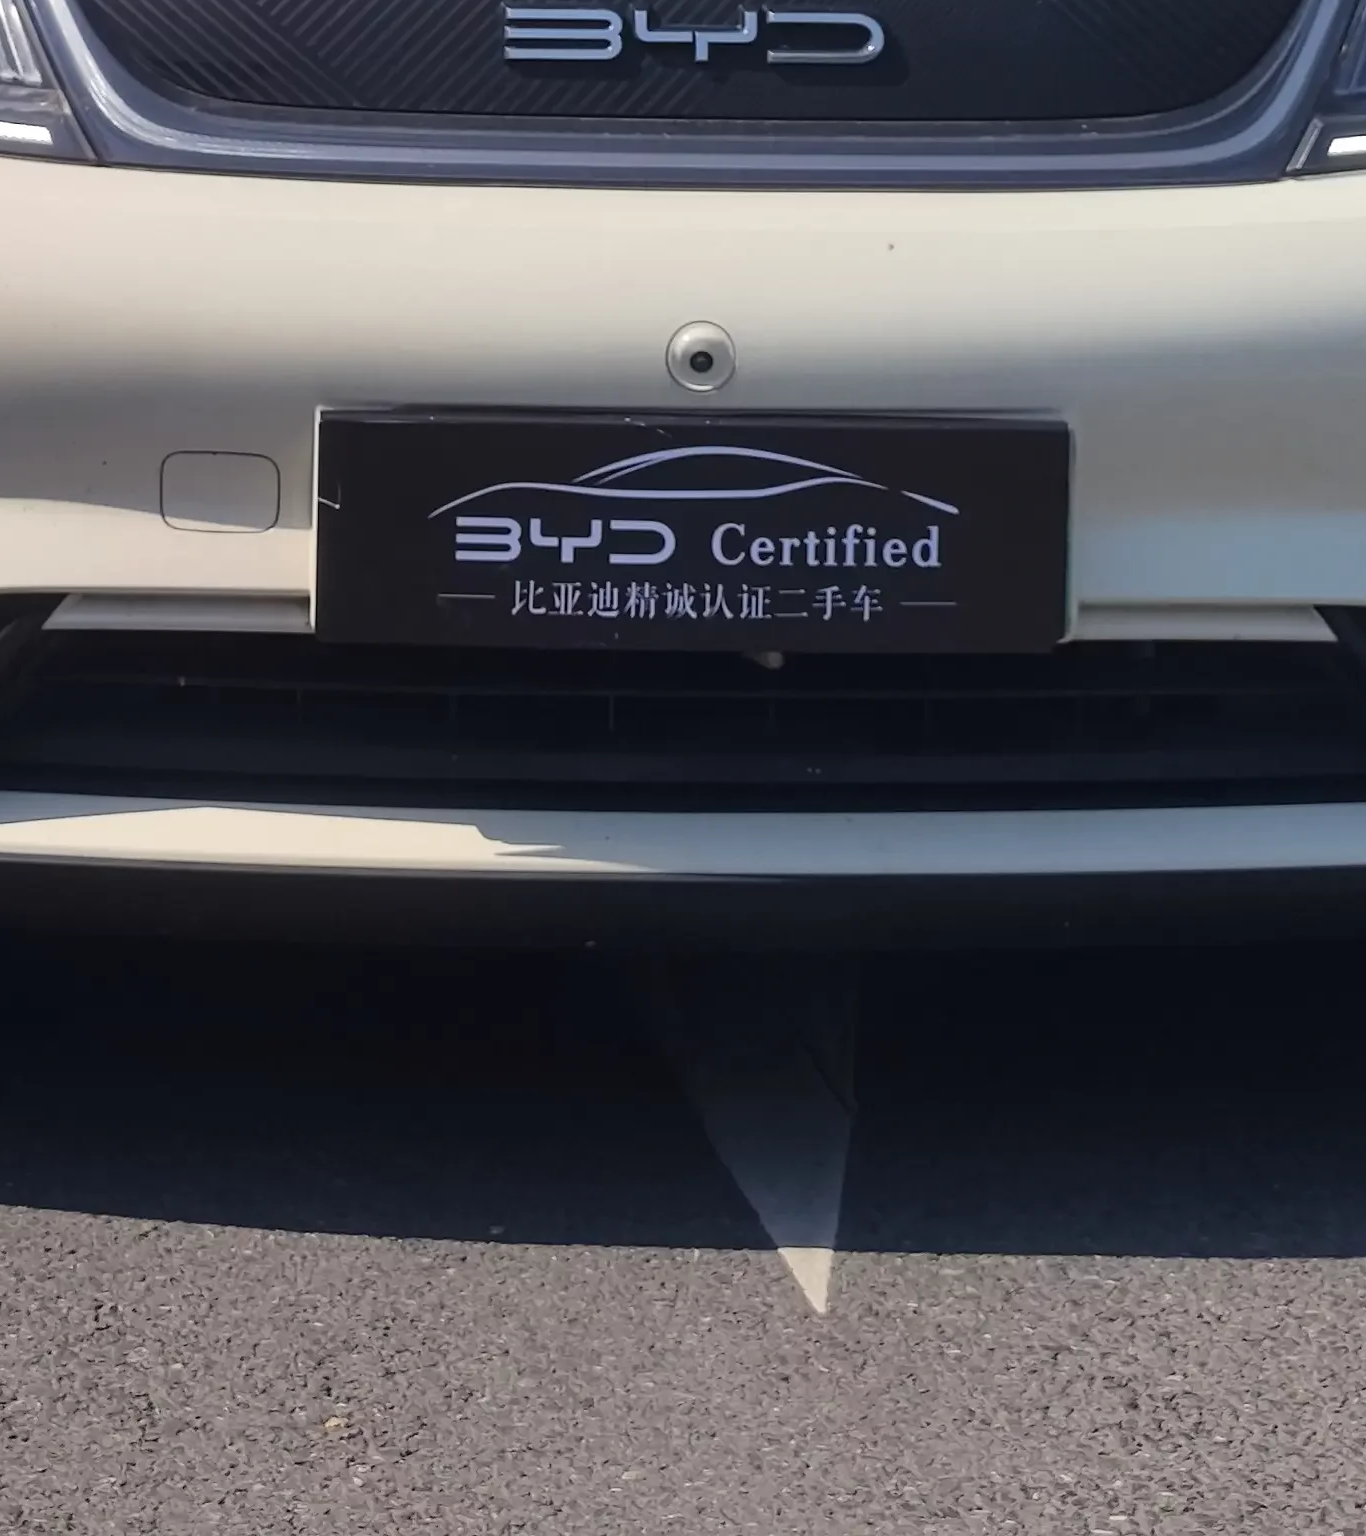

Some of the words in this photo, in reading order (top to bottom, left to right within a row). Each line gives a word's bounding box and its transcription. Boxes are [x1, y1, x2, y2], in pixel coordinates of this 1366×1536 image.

[503, 5, 885, 64] BYD
[455, 516, 676, 565] BYD
[711, 522, 942, 568] Certified
[511, 579, 883, 622] 比亚迪精诚认证二手车
